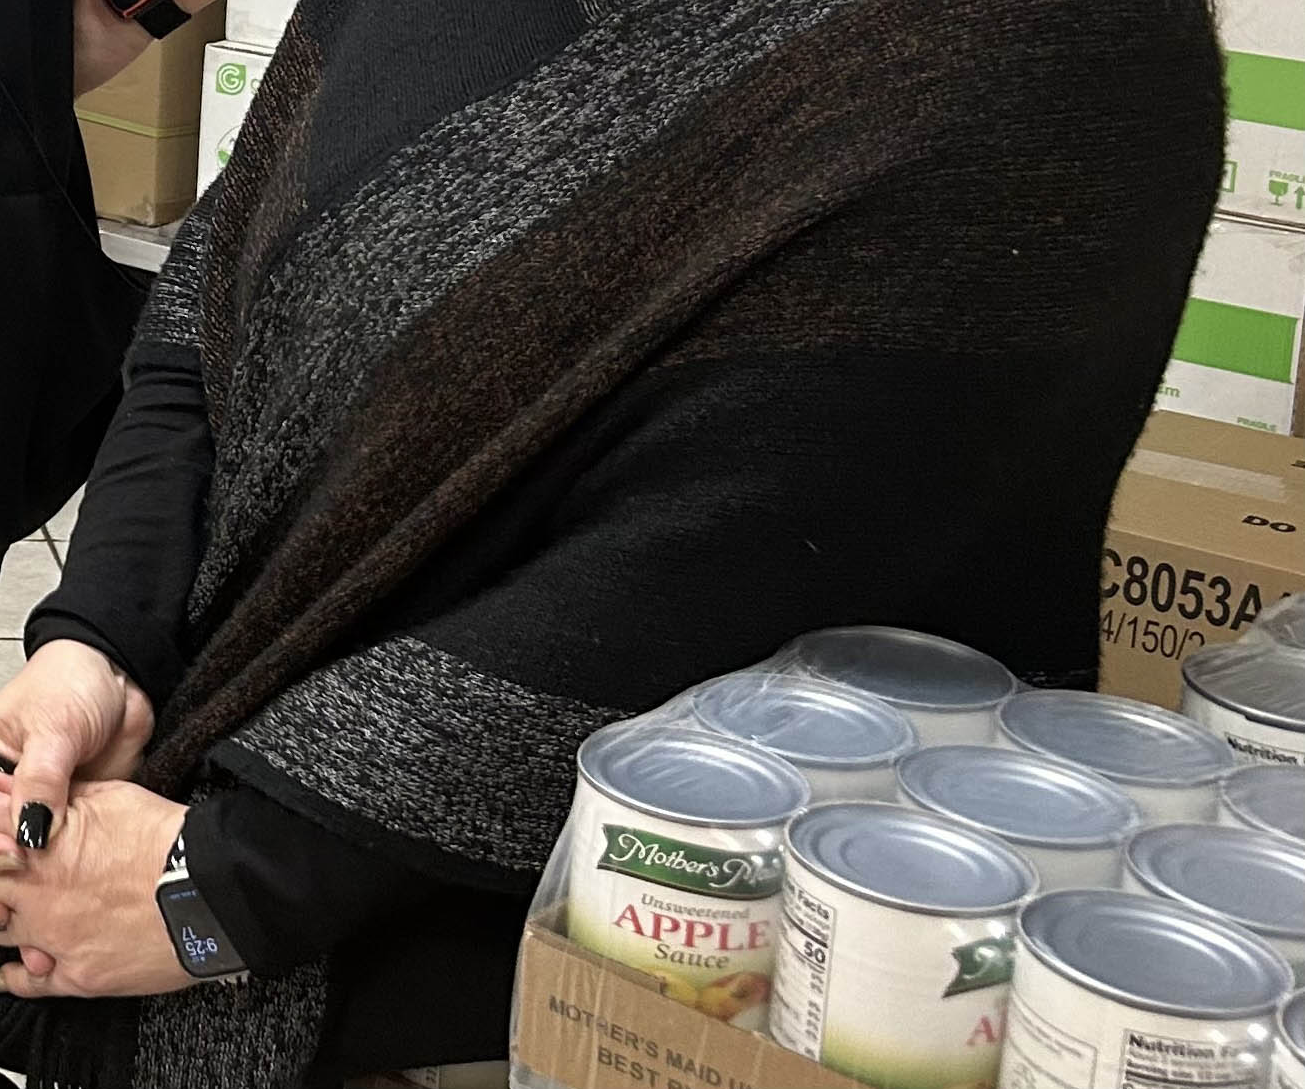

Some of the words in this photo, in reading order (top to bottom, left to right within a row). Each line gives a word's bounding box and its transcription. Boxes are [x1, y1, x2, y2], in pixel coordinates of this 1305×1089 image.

[609, 833, 719, 879] Mother's
[641, 892, 751, 919] Unsweetened
[797, 886, 830, 921] Facts
[612, 903, 771, 951] APPLE
[654, 943, 729, 969] Sauce
[803, 941, 826, 963] 50
[597, 1045, 661, 1089] BEST
[666, 1047, 722, 1087] MAID
